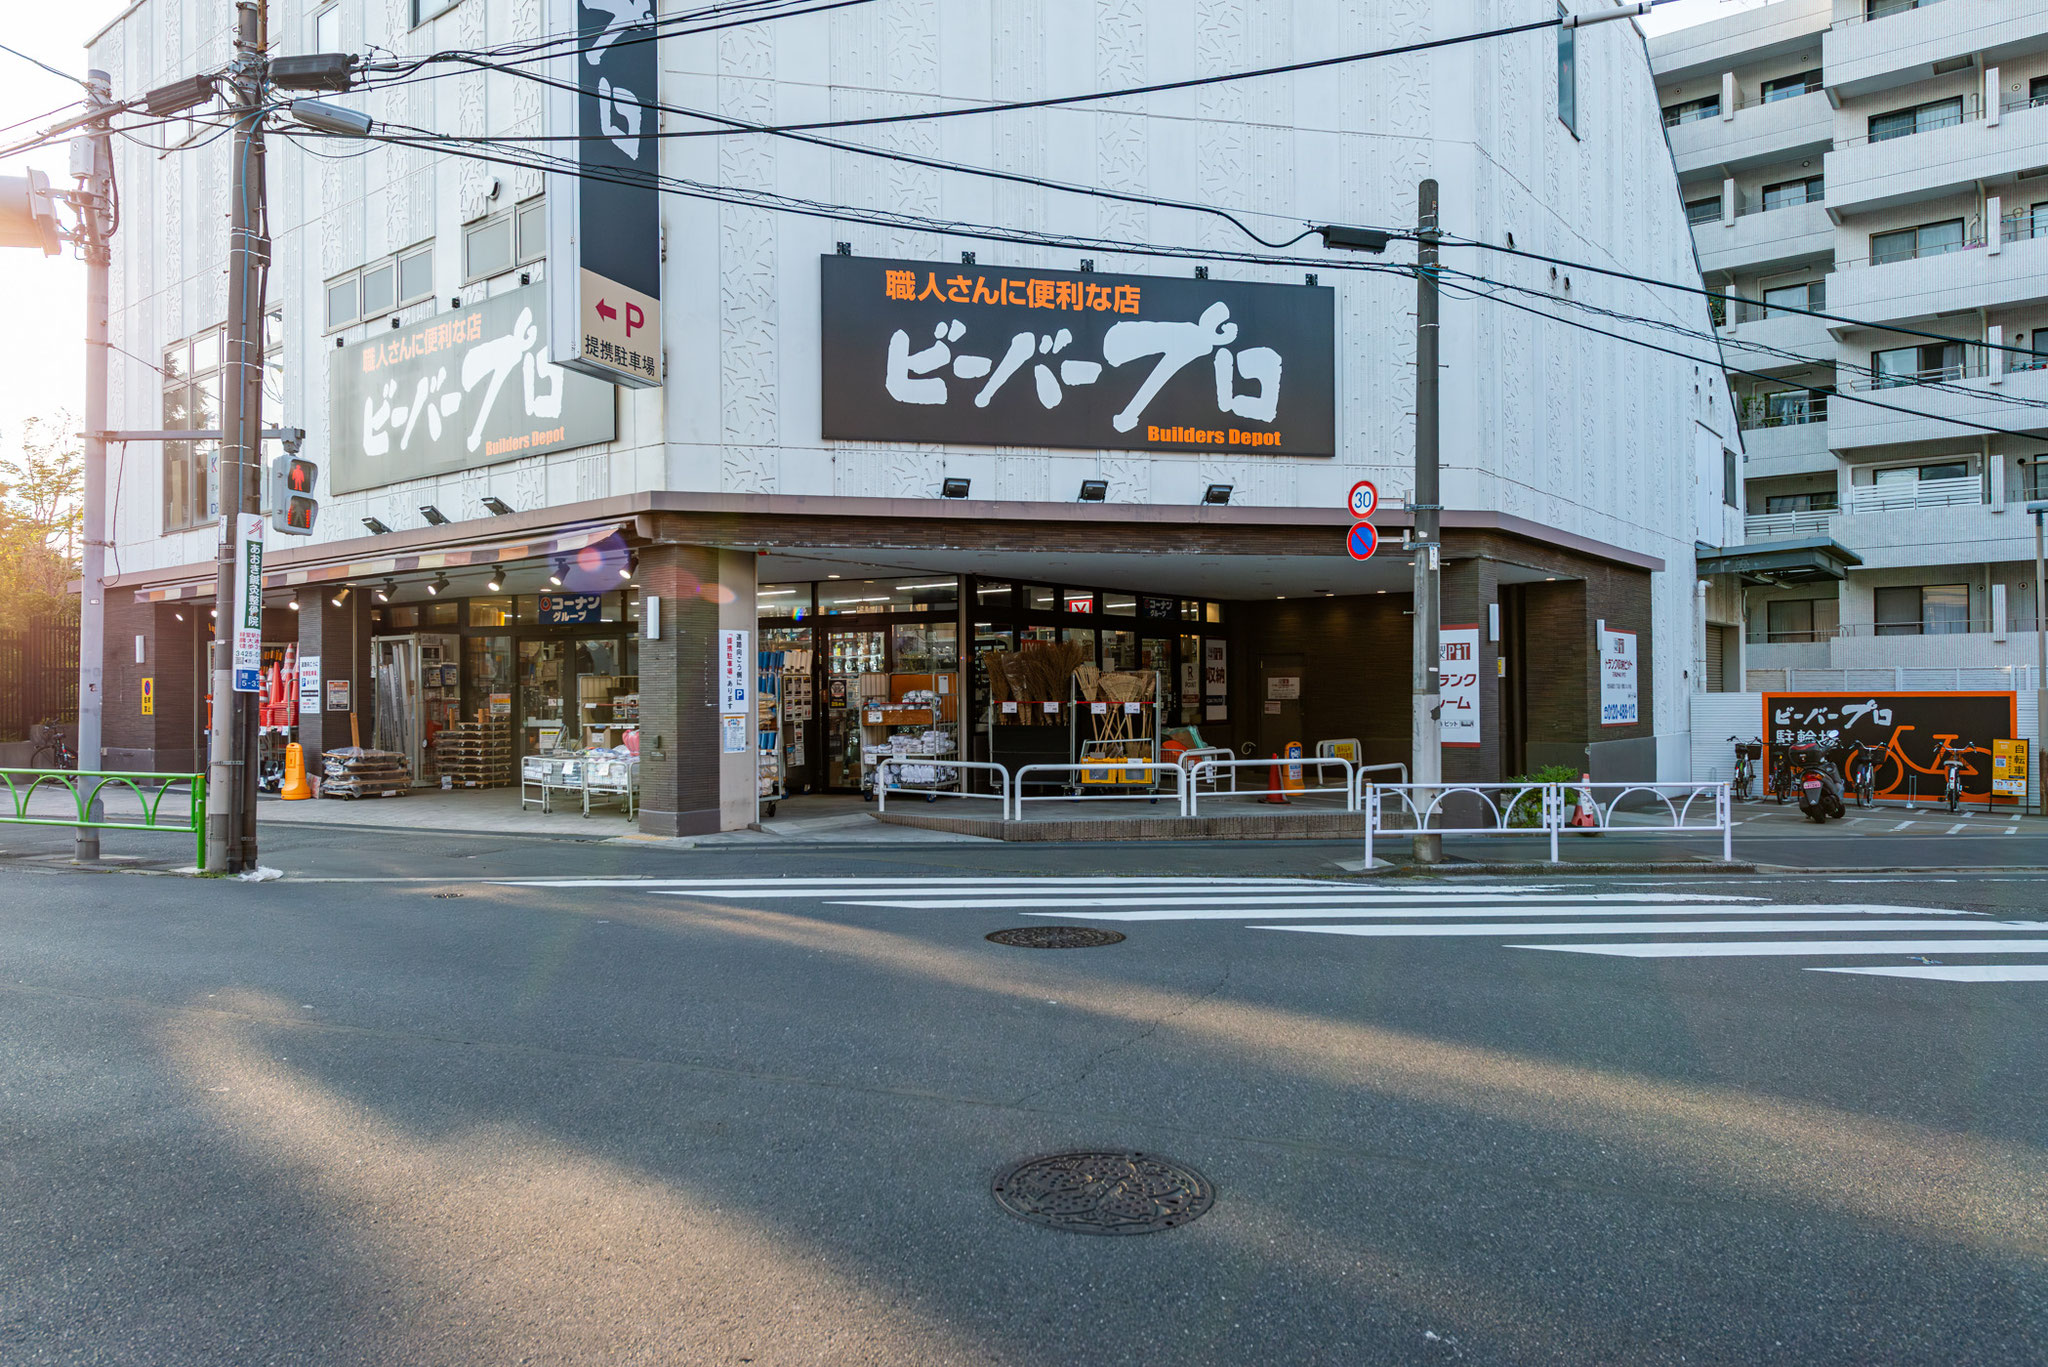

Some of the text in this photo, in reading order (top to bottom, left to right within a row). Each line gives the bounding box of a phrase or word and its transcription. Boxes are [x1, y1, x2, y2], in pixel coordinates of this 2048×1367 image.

[886, 269, 1141, 315] 職人さんに便利な店
[625, 301, 645, 338] P
[362, 312, 483, 374] 職人さんに便利な店
[585, 333, 656, 377] 提携駐車場
[363, 306, 564, 456] ビーバープロ
[885, 301, 1282, 433] ビーバープロ
[485, 426, 565, 457] Builders Depot
[1147, 425, 1282, 447] Builders Depot
[1354, 490, 1372, 509] 30
[551, 596, 601, 611] コーナン
[552, 609, 588, 623] グループ
[735, 633, 743, 686] 道路向こう側に
[1775, 699, 1893, 729] ビーバープロ
[2013, 744, 2025, 775] 自転車
